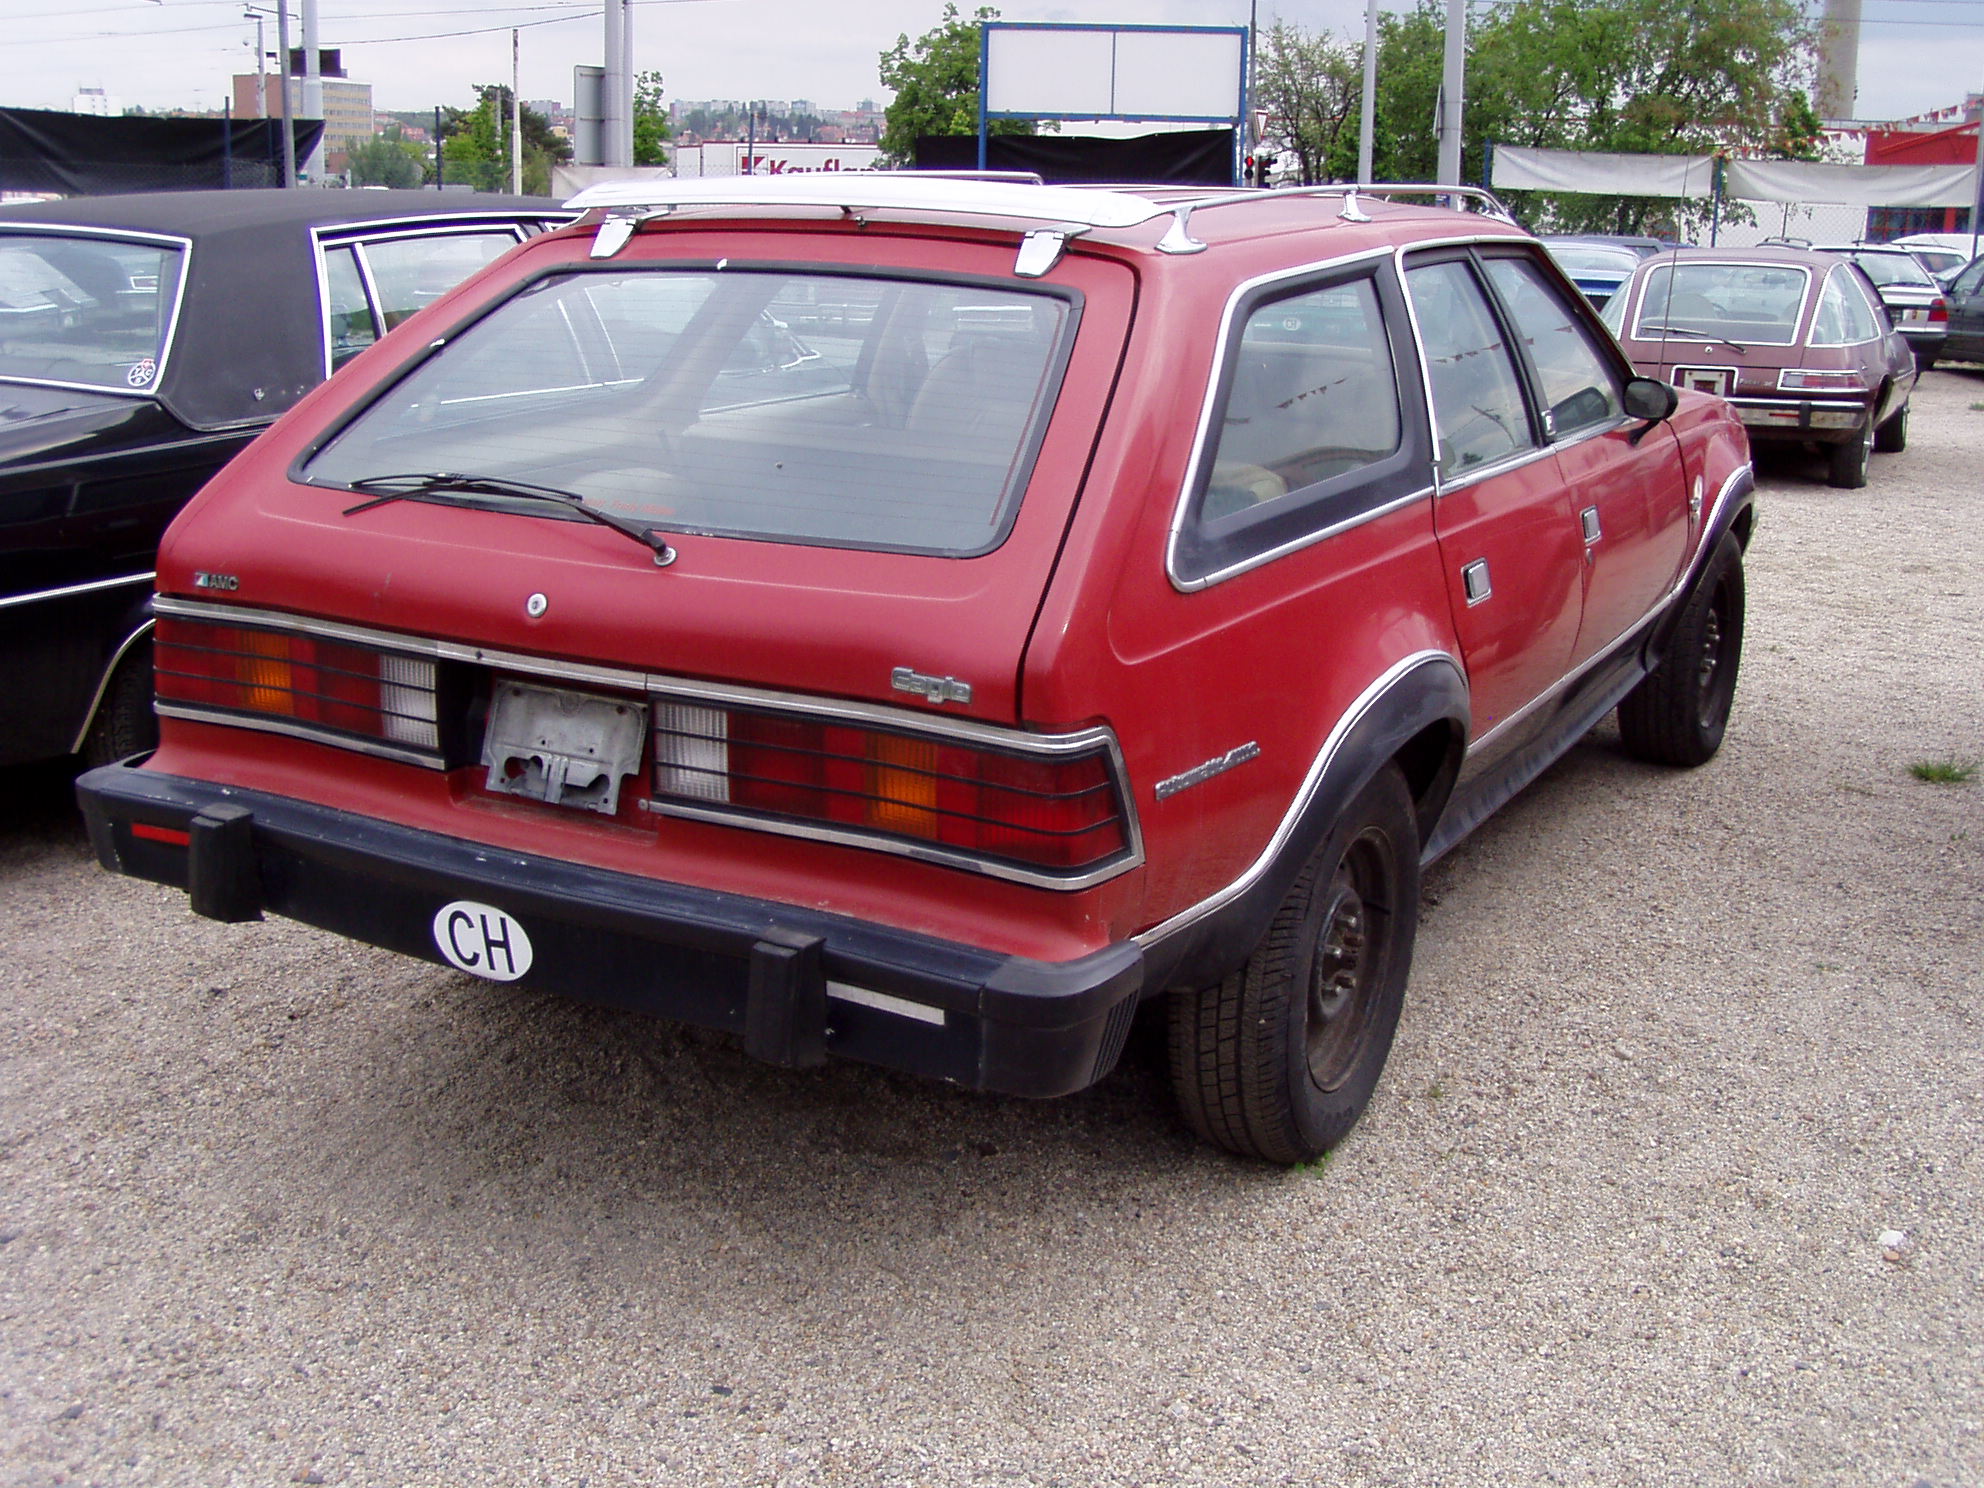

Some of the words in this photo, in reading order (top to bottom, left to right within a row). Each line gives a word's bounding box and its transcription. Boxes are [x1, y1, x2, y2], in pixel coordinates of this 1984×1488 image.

[209, 573, 239, 591] AMC
[891, 666, 972, 704] Eagle
[448, 909, 516, 974] CH
